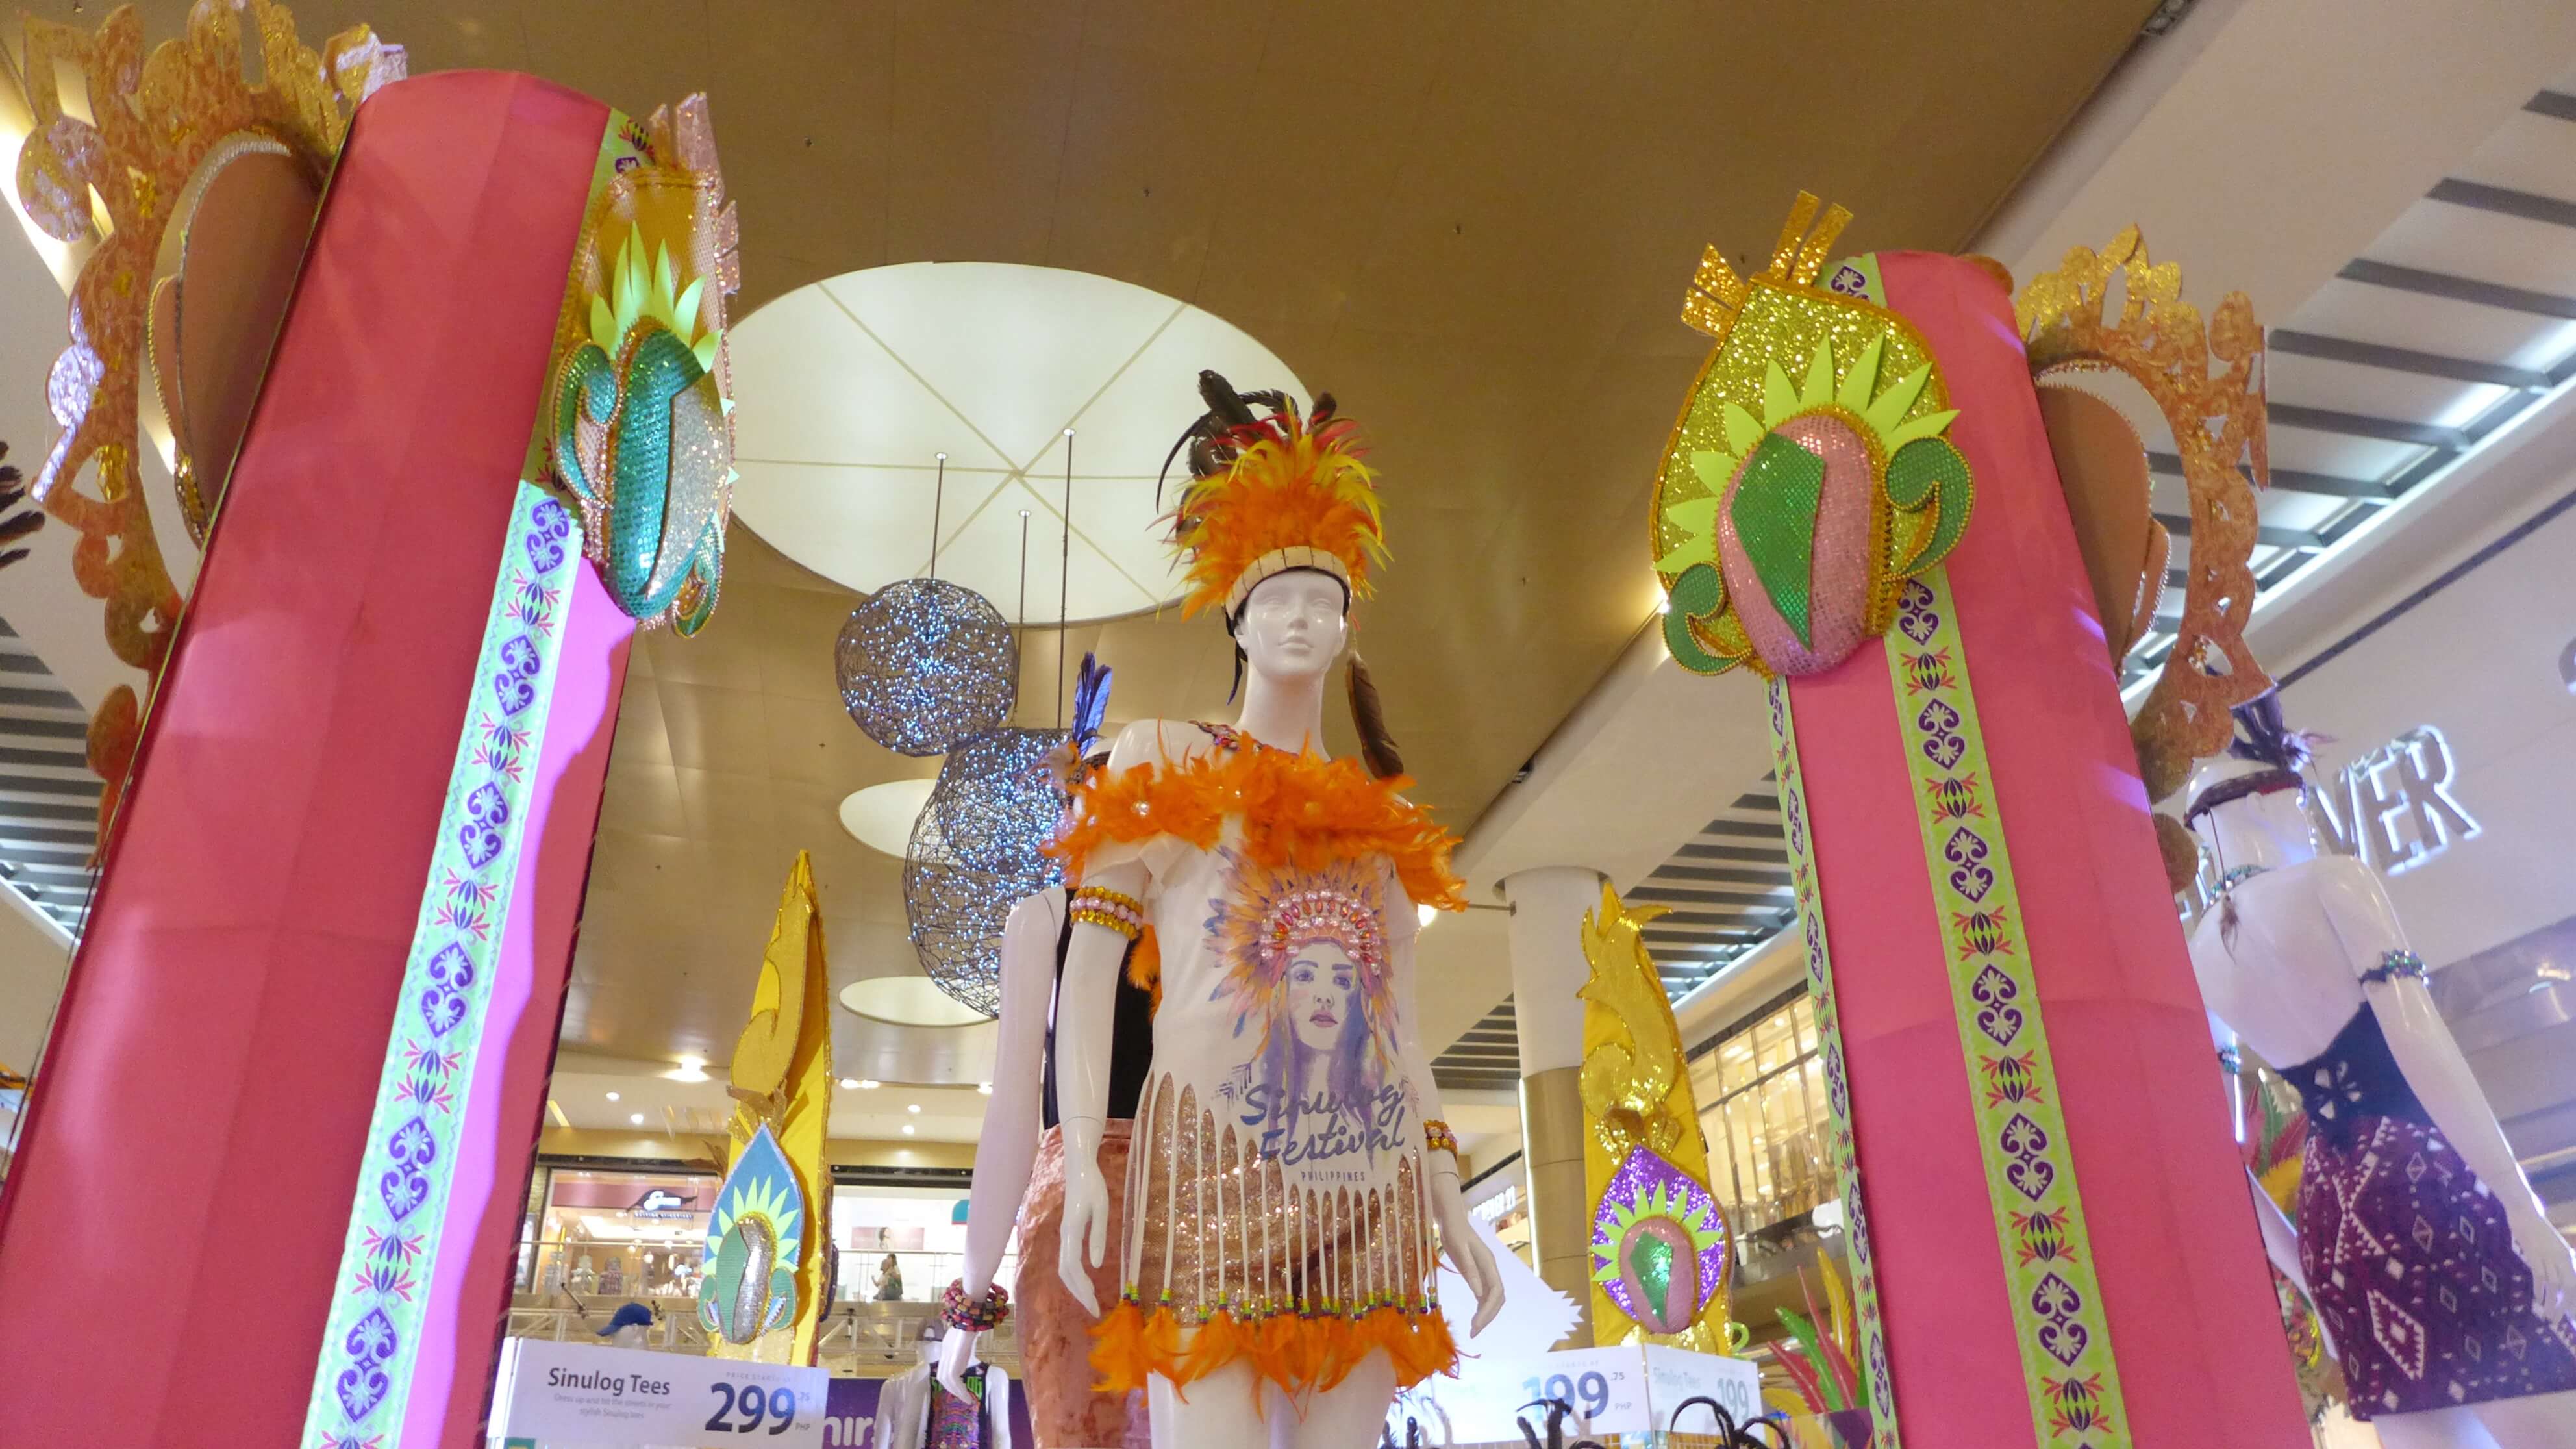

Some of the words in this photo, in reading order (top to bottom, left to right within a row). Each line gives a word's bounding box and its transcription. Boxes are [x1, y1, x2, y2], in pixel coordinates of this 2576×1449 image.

[1260, 1105, 1405, 1165] Festival
[1301, 1171, 1365, 1181] PHILIPPINES
[548, 1367, 625, 1396] Sinulog
[630, 1374, 670, 1395] Tees
[1522, 1371, 1609, 1420] 199
[705, 1382, 795, 1435] 299
[1614, 1402, 1633, 1411] PHP
[1718, 1378, 1750, 1422] 199
[795, 1422, 811, 1431] PHP
